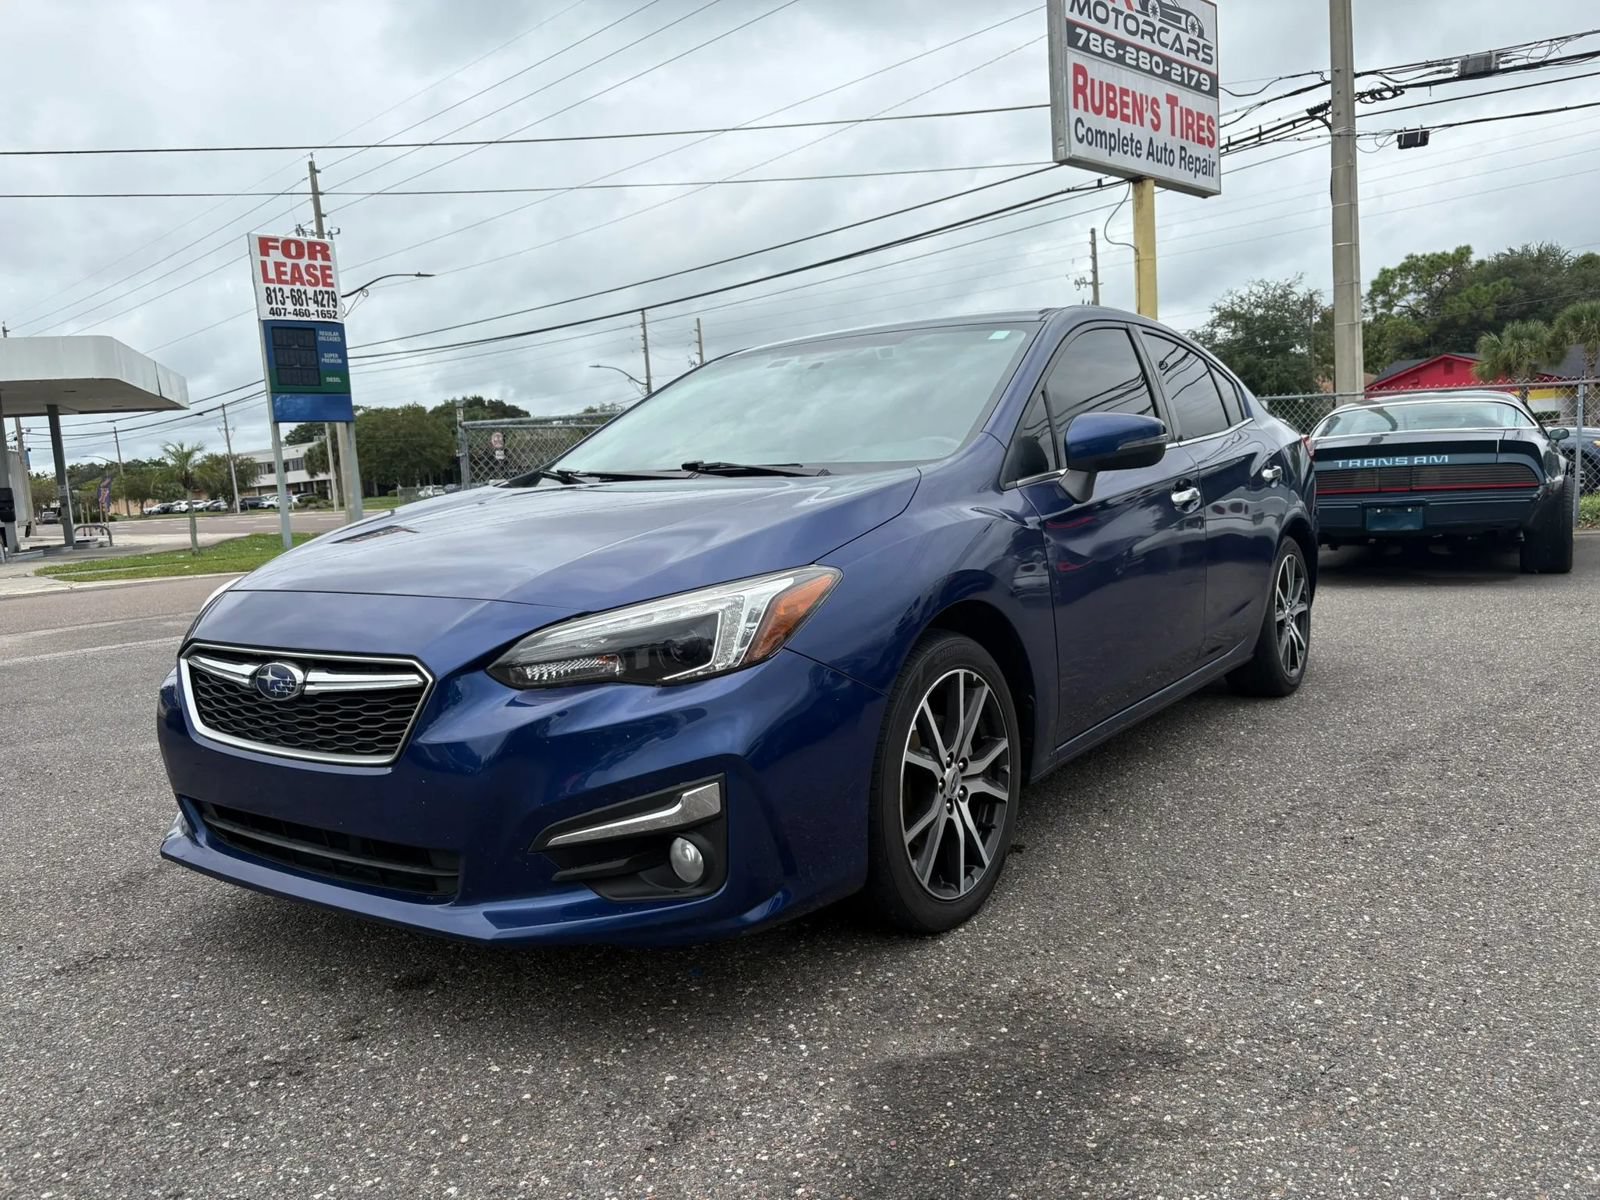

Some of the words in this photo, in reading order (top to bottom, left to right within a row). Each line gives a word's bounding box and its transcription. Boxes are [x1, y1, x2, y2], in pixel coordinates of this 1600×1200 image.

[1069, 0, 1214, 65] MOTORCARS
[1075, 27, 1211, 91] 786-280-2179
[1073, 63, 1162, 132] RUBEN'S
[1166, 93, 1216, 149] TIRES
[1074, 117, 1143, 158] Complete
[1146, 137, 1175, 167] Auto
[1179, 145, 1216, 179] Repair
[257, 236, 332, 262] FOR
[260, 260, 335, 288] LEASE
[265, 286, 338, 309] 813-681-4279
[269, 307, 338, 320] 407-460-1652
[1333, 456, 1408, 468] TRANS
[1414, 454, 1449, 466] AM
